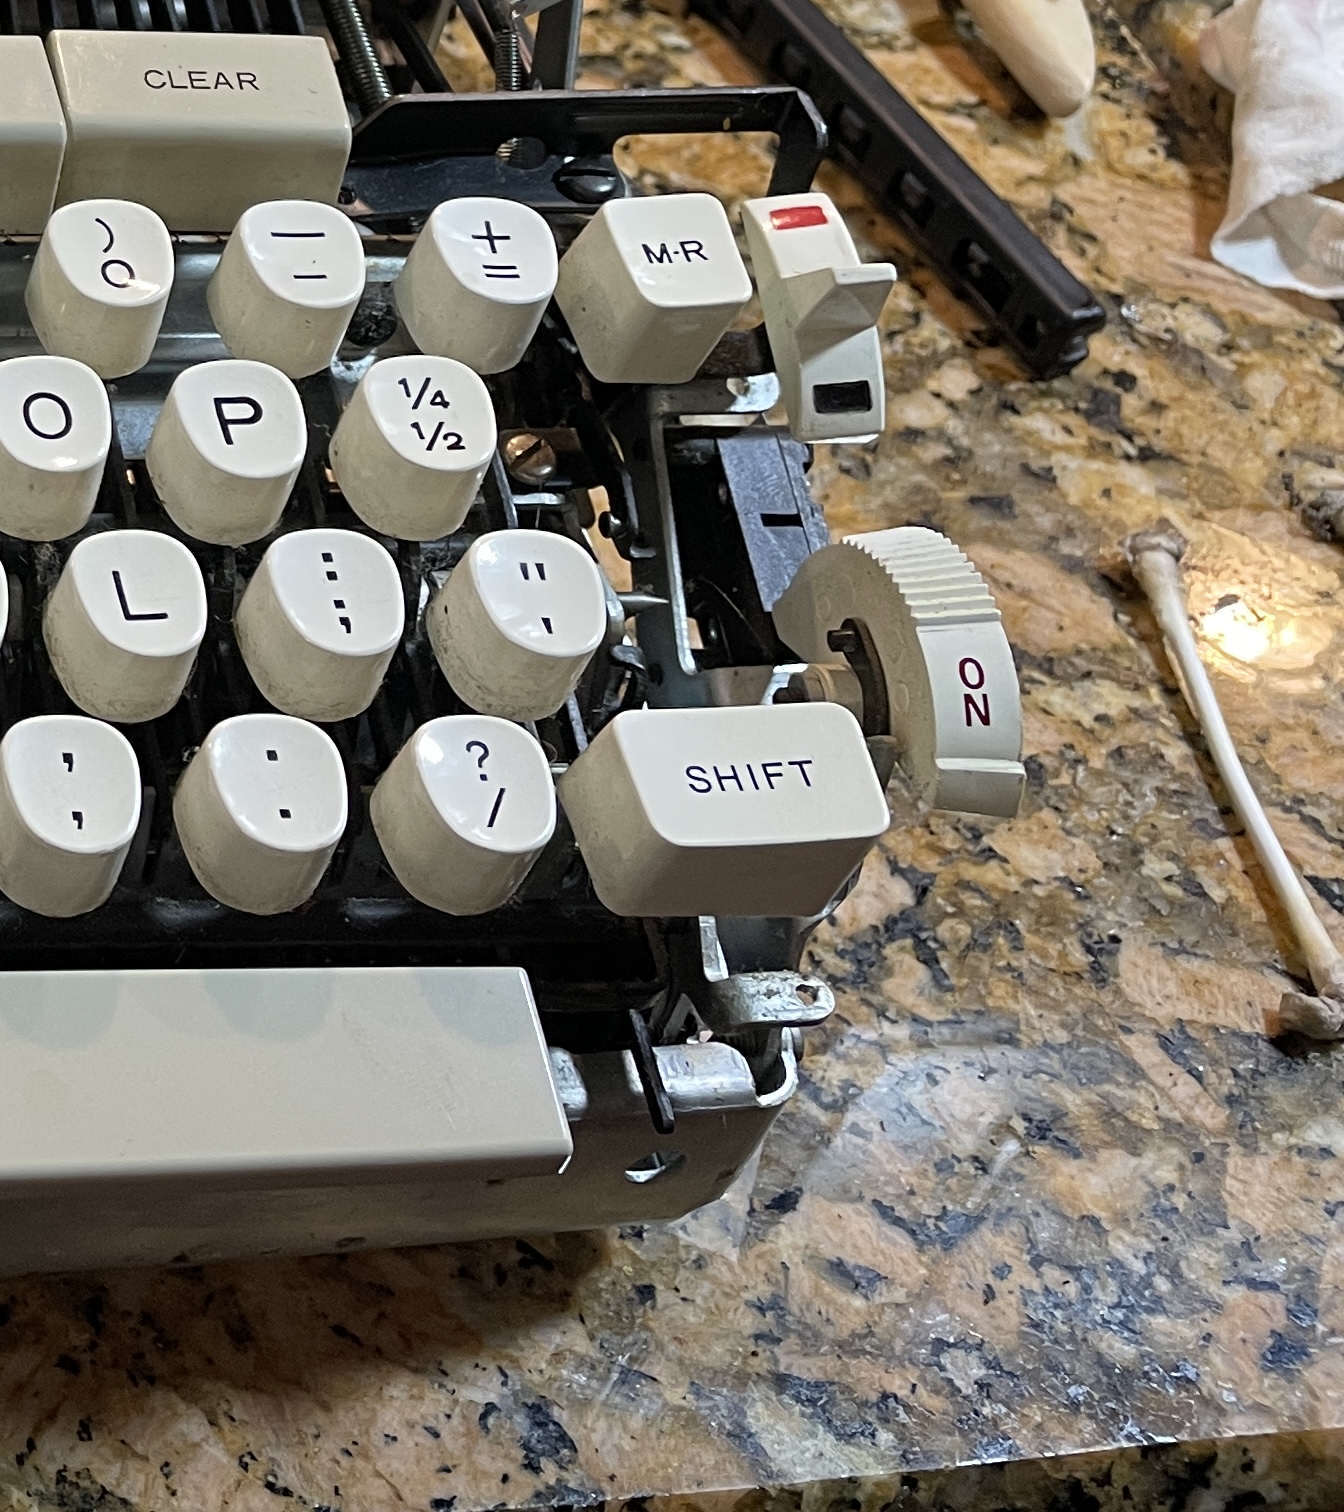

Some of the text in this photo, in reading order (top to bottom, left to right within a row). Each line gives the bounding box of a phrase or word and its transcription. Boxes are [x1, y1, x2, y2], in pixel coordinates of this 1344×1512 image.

[143, 69, 260, 91] CLEAR
[471, 220, 511, 254] +
[641, 240, 709, 264] M-R
[482, 264, 521, 279] =
[22, 392, 73, 440] O
[213, 396, 263, 446] P
[111, 570, 169, 621] L
[958, 657, 991, 728] ON
[465, 740, 490, 782] ?
[685, 759, 813, 794] SHIFT
